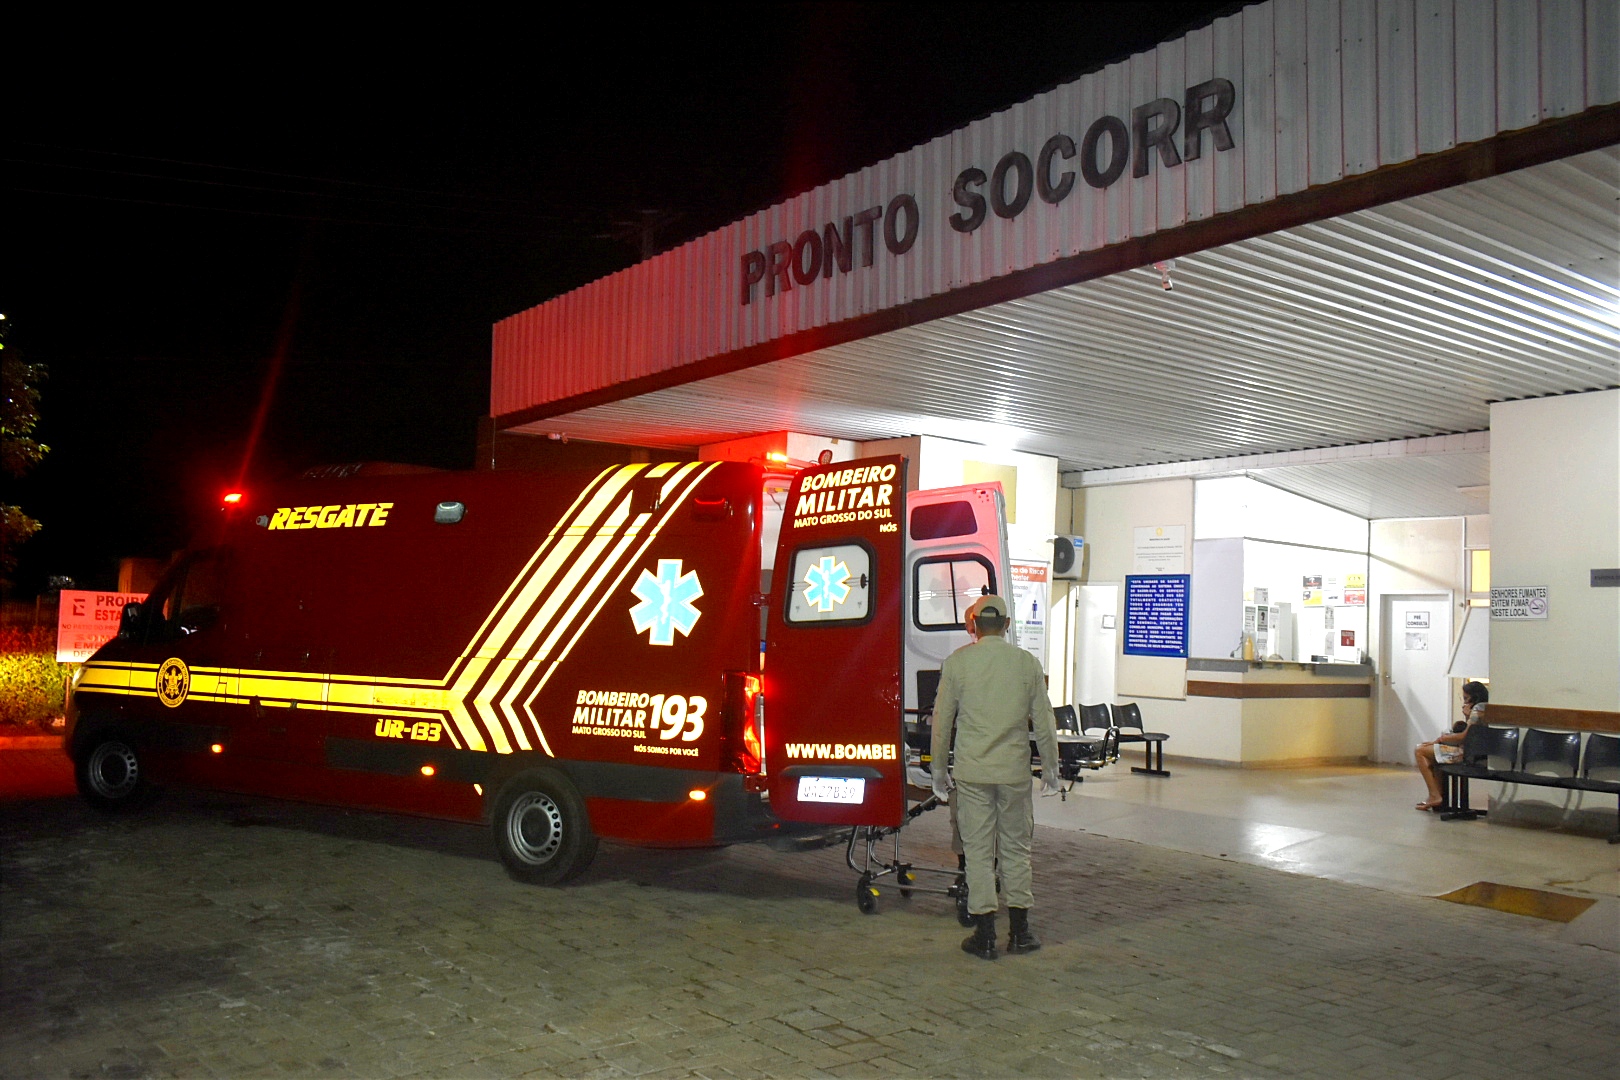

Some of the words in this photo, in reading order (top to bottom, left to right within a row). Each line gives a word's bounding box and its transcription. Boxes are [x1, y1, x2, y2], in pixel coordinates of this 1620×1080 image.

[740, 193, 920, 306] PRONTO
[948, 77, 1236, 235] SOCORR
[800, 464, 896, 493] BOMBEIRO
[794, 484, 893, 517] MILITAR
[268, 502, 395, 531] RESGATE
[793, 516, 819, 529] MATO
[819, 511, 857, 525] GROSSO
[857, 510, 873, 521] DO
[873, 508, 892, 519] SUL
[879, 521, 898, 533] NÓS
[1491, 589, 1518, 599] SENHORES
[1519, 588, 1546, 598] FUMANTES
[1491, 599, 1510, 608] EVITEM
[1511, 598, 1530, 607] FUMAR
[1491, 608, 1509, 617] NESTE
[1510, 608, 1529, 617] LOCAL
[576, 689, 650, 709] BOMBEIRO
[572, 706, 647, 729] MILITAR
[649, 693, 708, 742] 193
[375, 718, 442, 742] UR-133
[571, 726, 592, 735] MATO
[592, 727, 621, 737] GROSSO
[621, 729, 633, 738] DO
[633, 730, 647, 739] SUL
[633, 744, 647, 753] NÓS
[647, 745, 669, 755] SOMOS
[669, 747, 682, 756] POR
[682, 747, 699, 757] VOCÊ
[785, 743, 897, 760] WWW.BOMBEI
